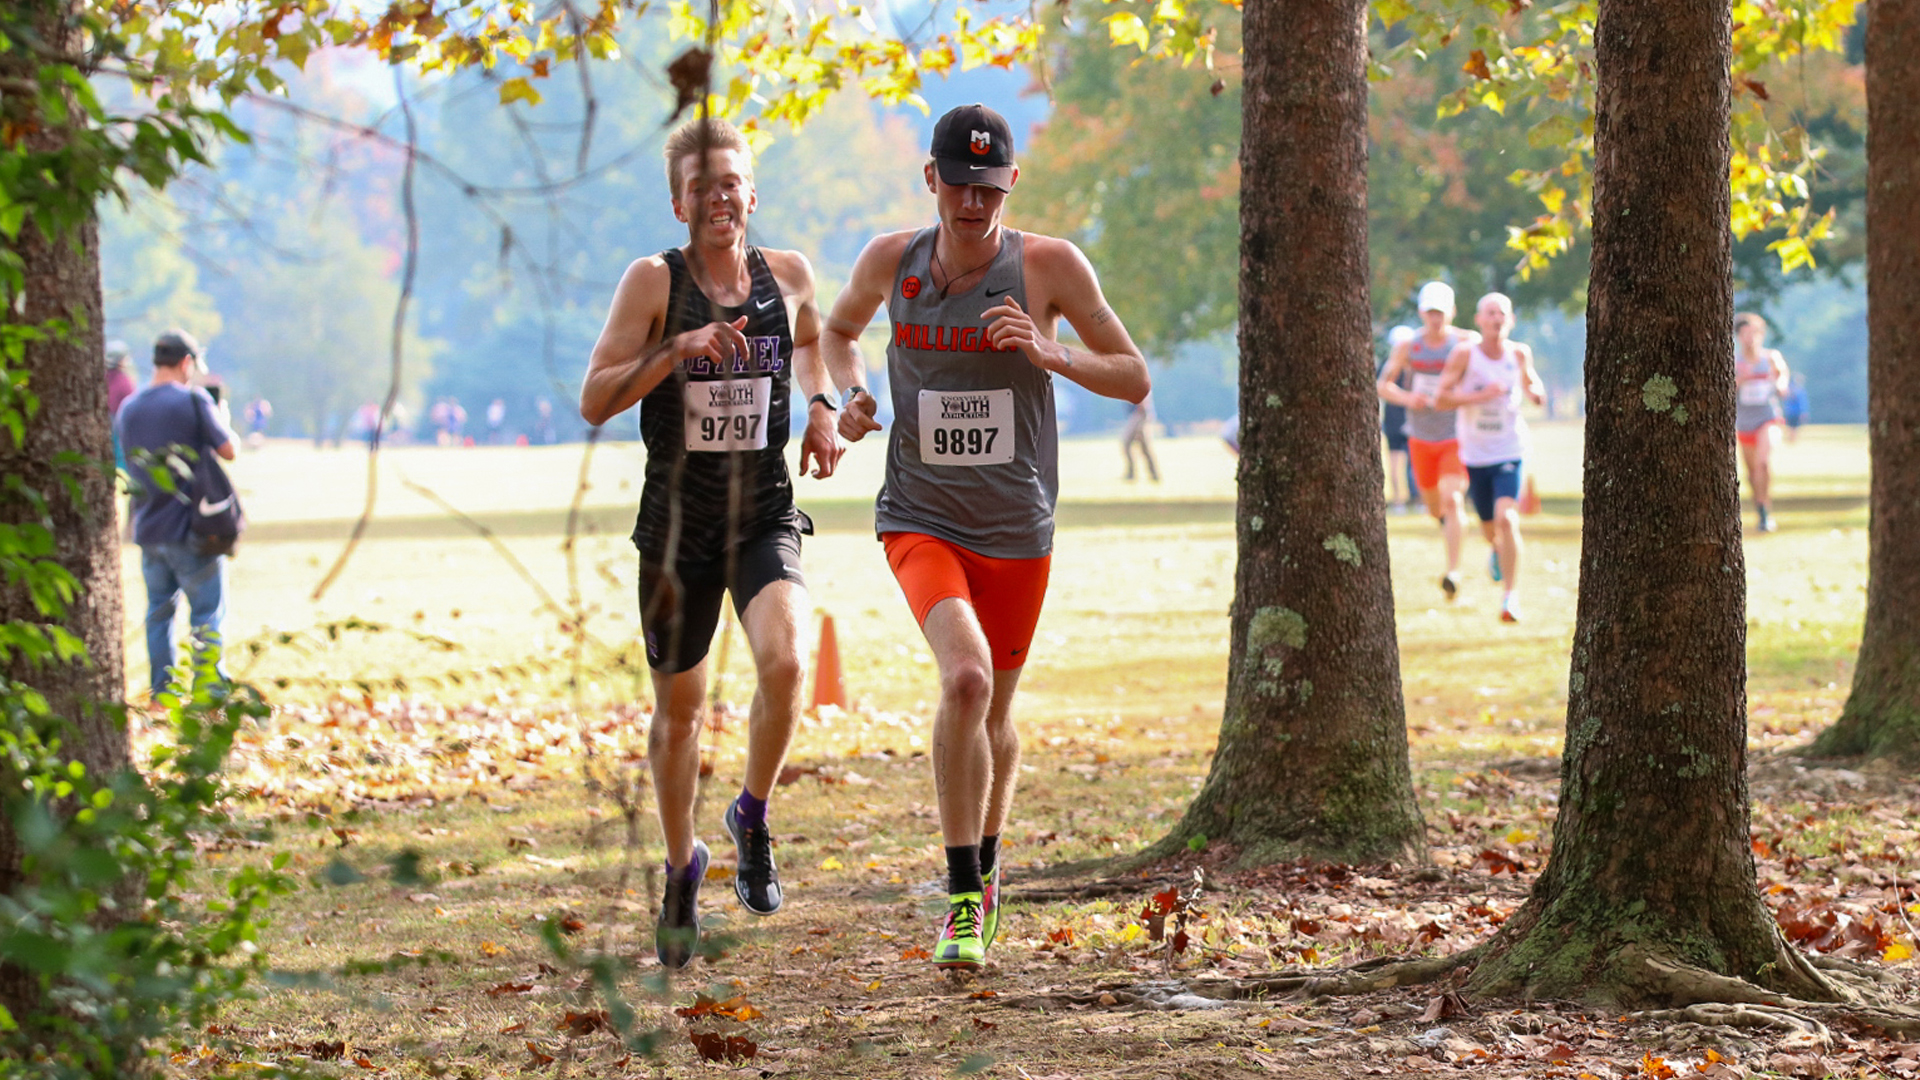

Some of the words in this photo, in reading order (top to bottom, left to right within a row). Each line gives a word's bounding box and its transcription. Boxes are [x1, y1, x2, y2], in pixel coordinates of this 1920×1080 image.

[894, 321, 1018, 353] MILLIGA
[701, 414, 762, 442] 9797
[933, 427, 999, 456] 9897
